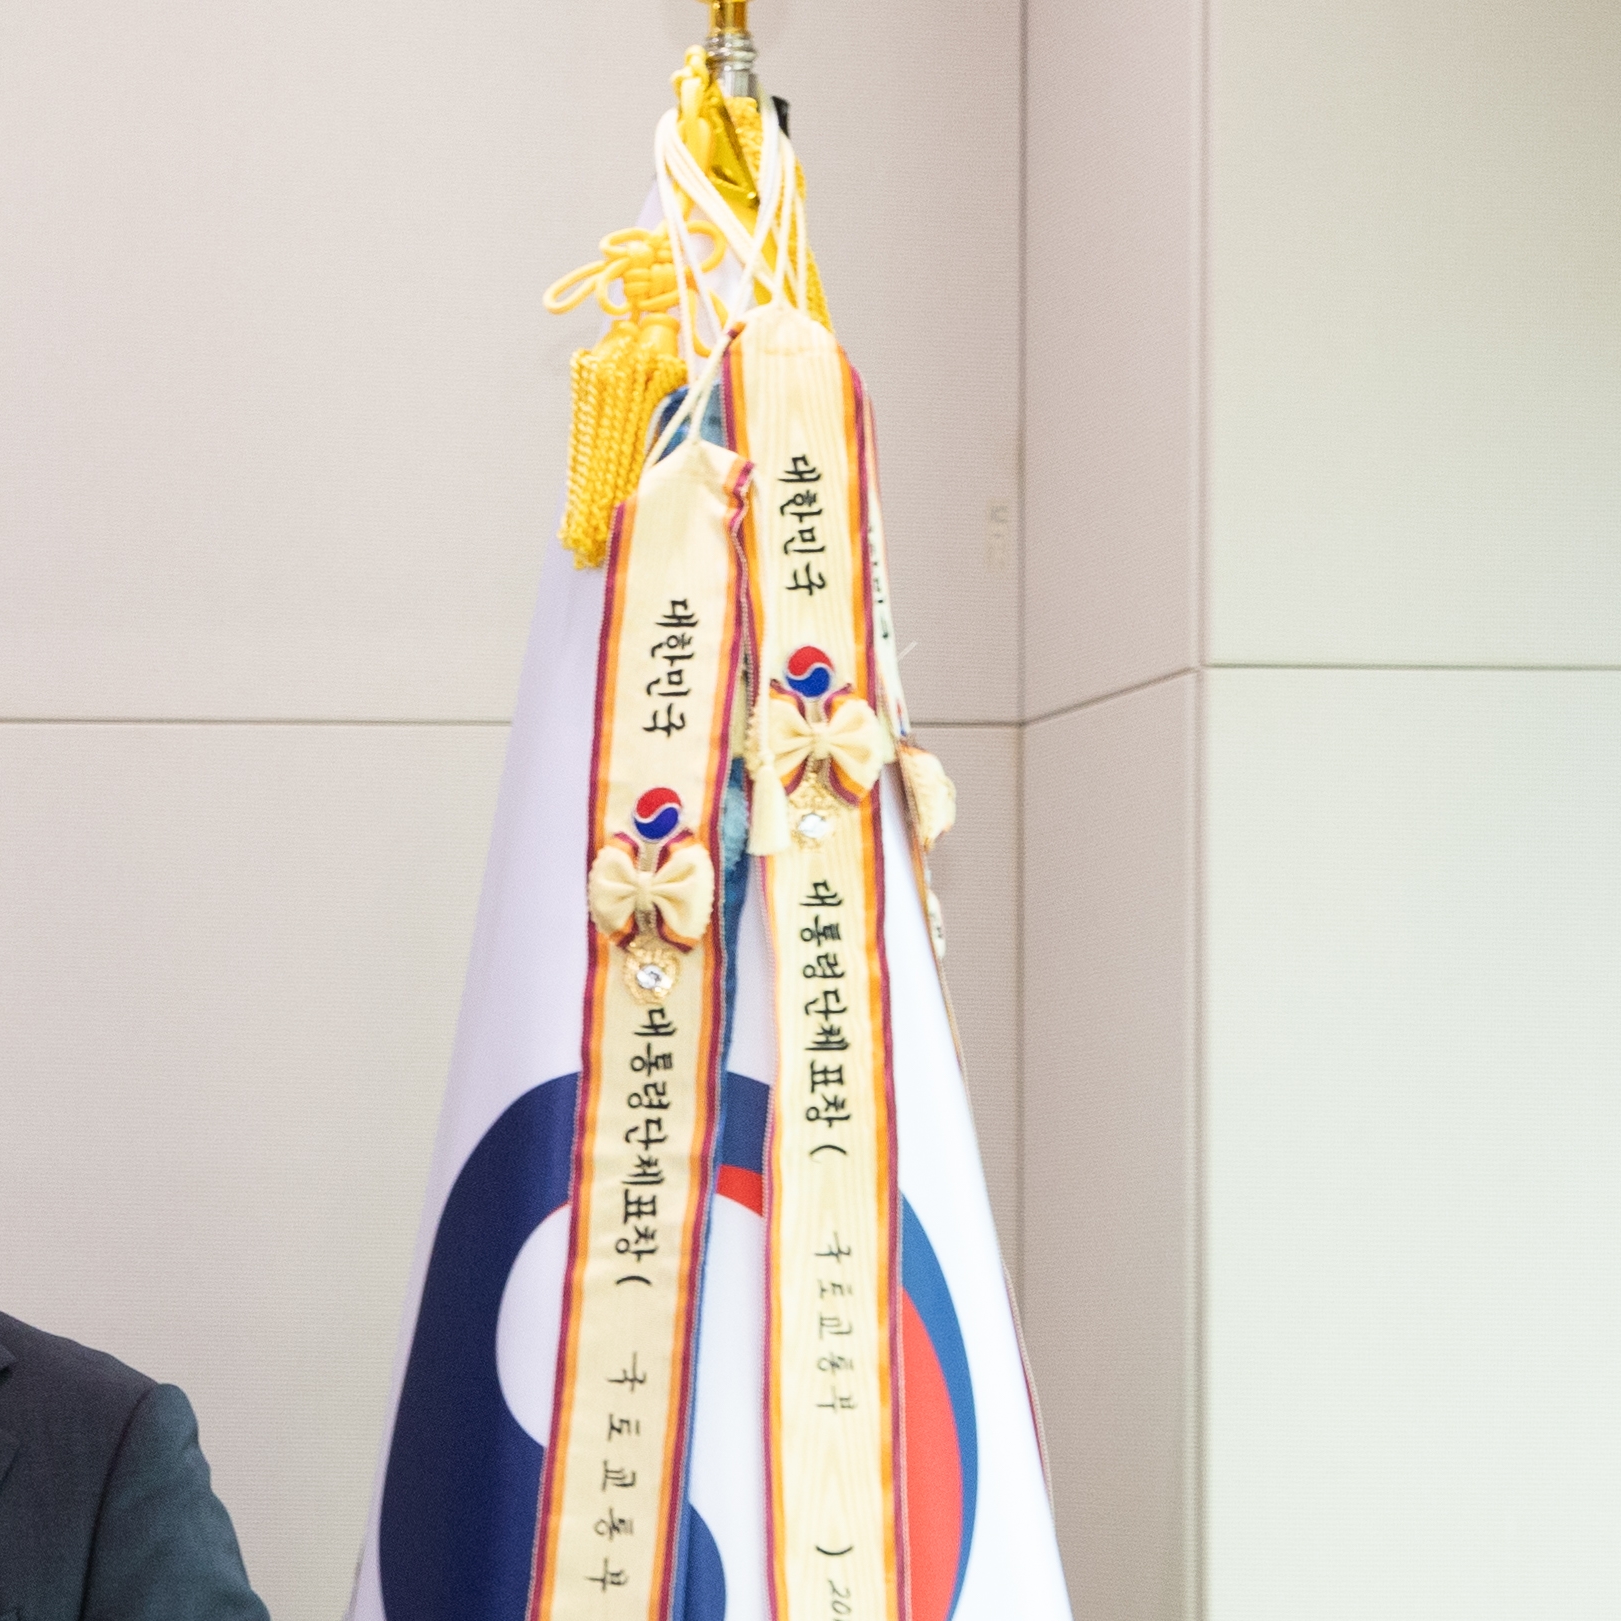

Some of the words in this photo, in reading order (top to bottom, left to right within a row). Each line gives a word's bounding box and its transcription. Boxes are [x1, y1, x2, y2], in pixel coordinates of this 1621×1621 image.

[777, 454, 826, 596] 대한민국
[642, 598, 699, 738] 대한민국
[584, 1350, 647, 1594] 국토교통부
